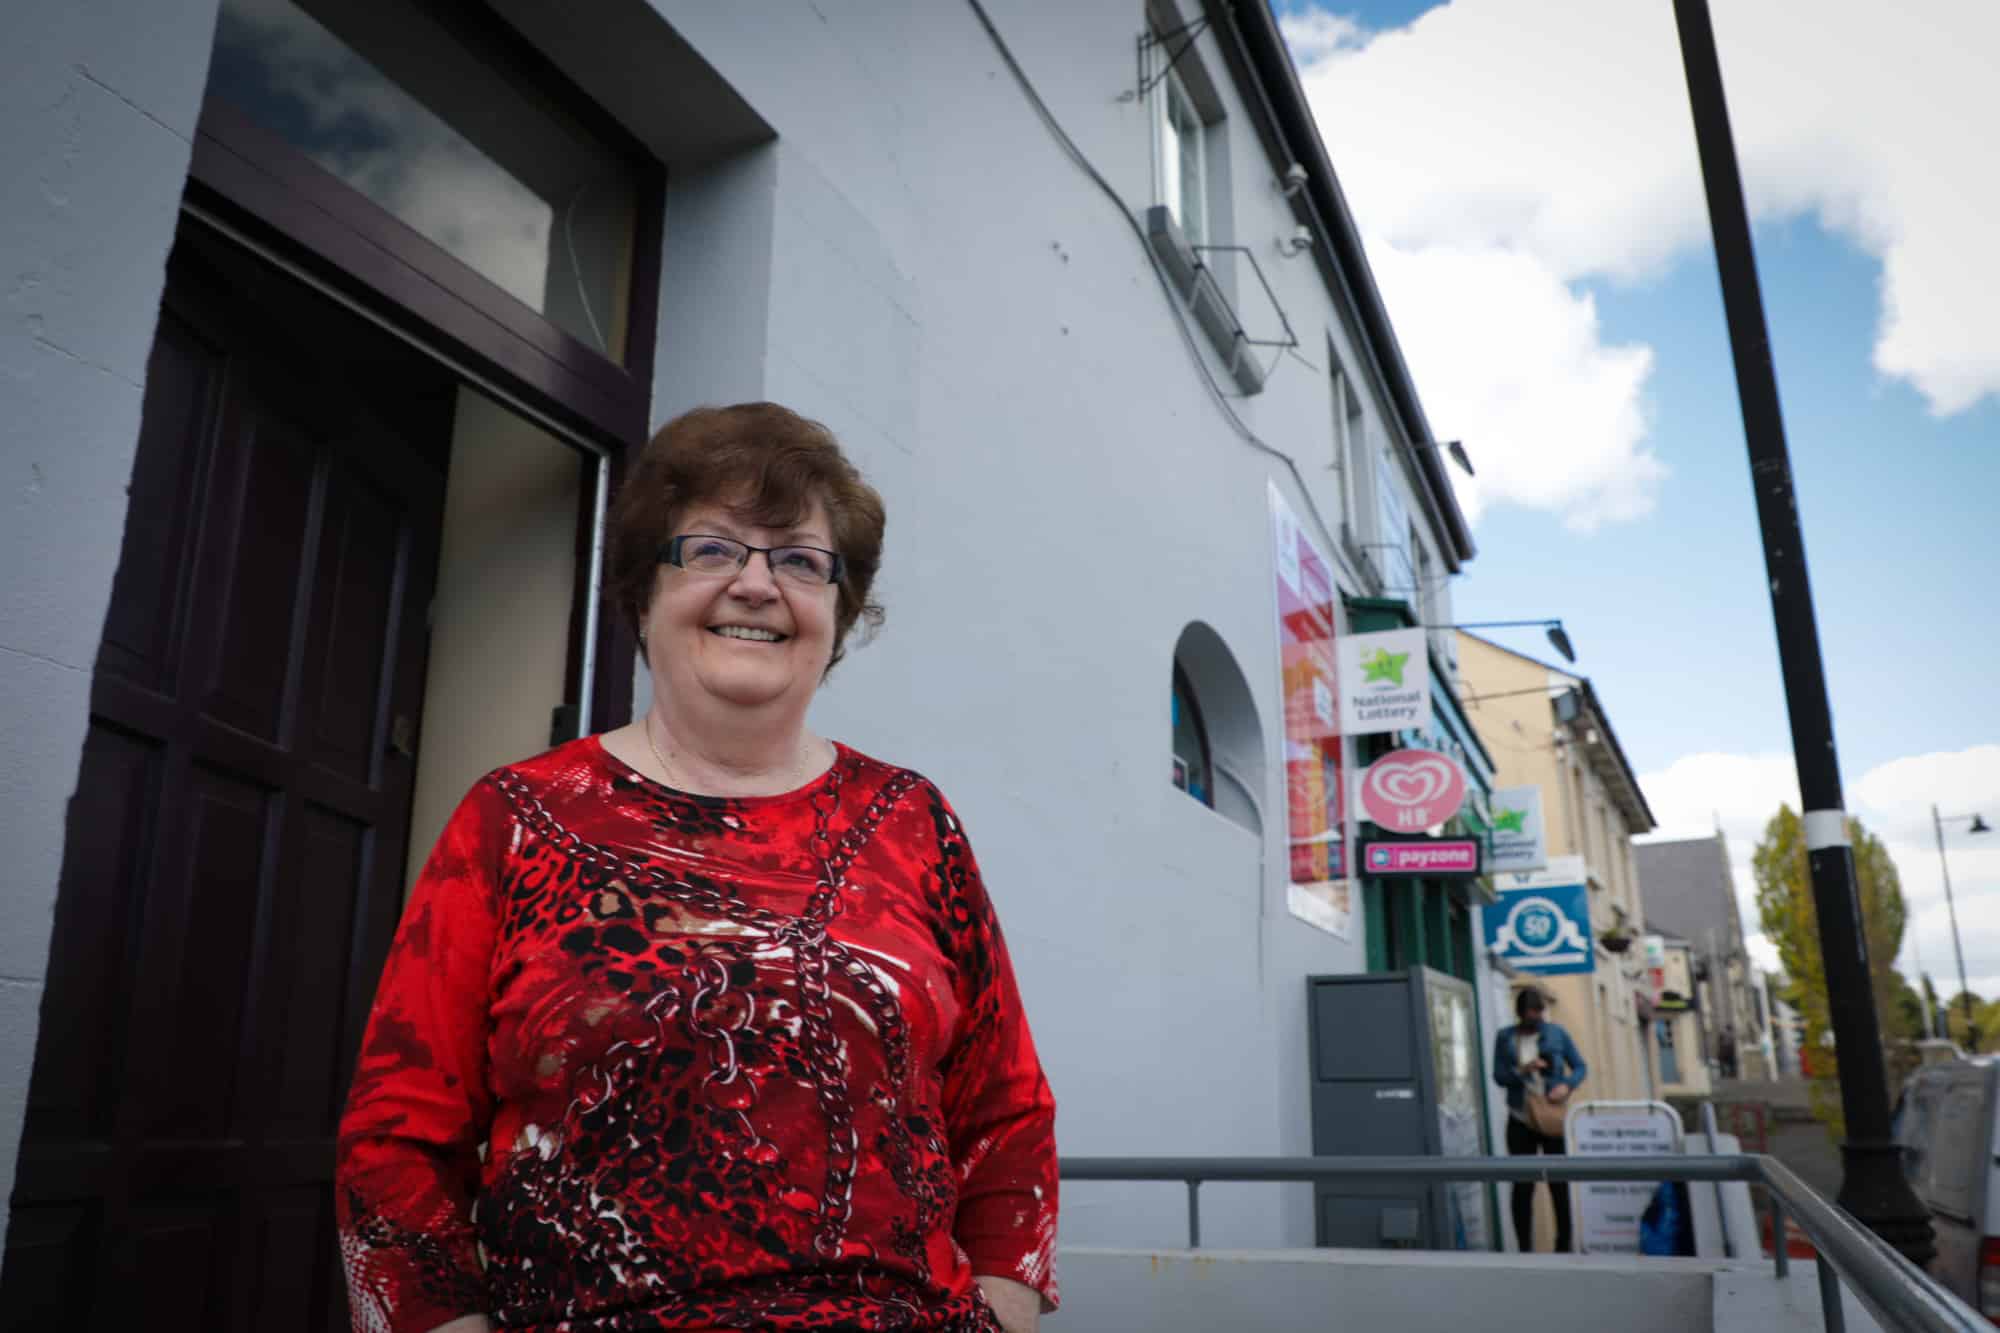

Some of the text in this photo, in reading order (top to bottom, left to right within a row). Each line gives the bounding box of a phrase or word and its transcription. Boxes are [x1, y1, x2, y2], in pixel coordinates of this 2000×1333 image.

[1353, 690, 1421, 707] National
[1358, 705, 1418, 721] Lottery
[1398, 849, 1470, 867] payzone
